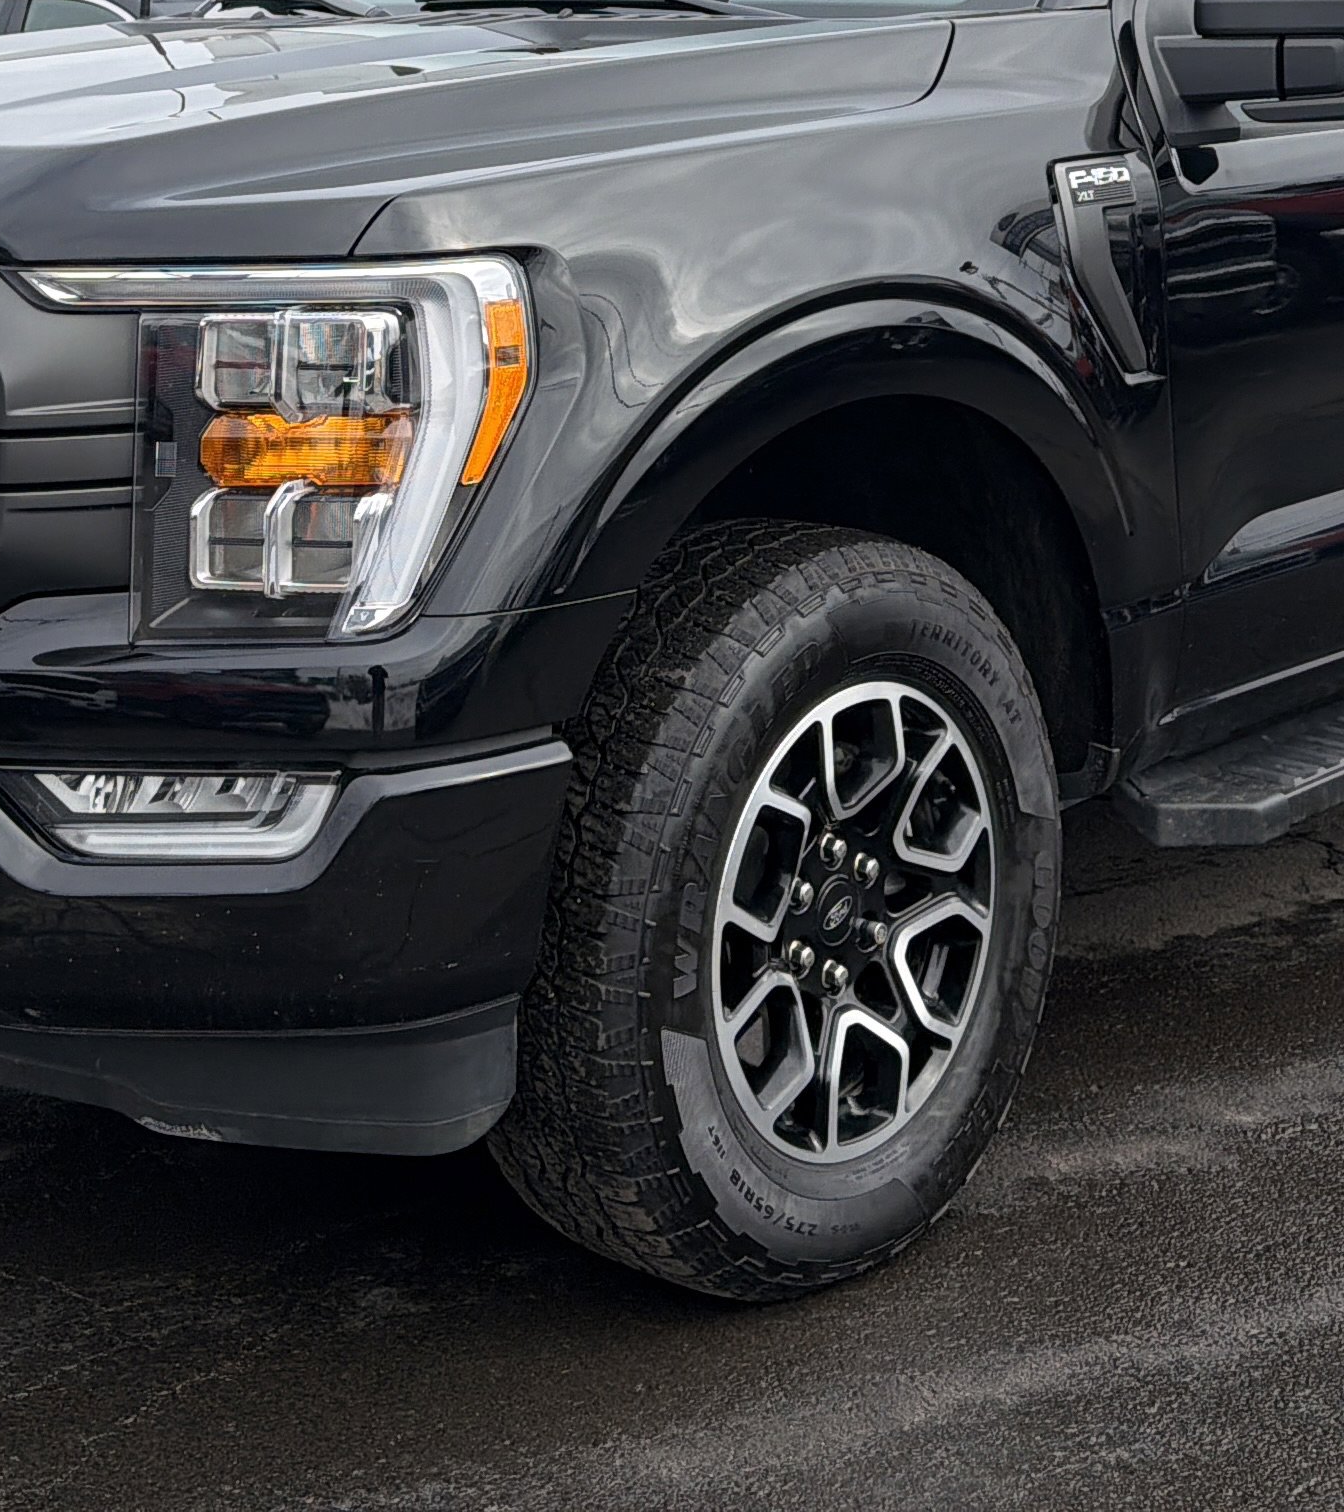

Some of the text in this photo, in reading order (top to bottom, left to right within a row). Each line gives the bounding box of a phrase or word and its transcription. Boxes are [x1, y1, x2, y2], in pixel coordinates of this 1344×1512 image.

[1068, 166, 1131, 189] F-150
[909, 618, 1001, 687] TERRITORY
[729, 1168, 818, 1237] 275/65R18
